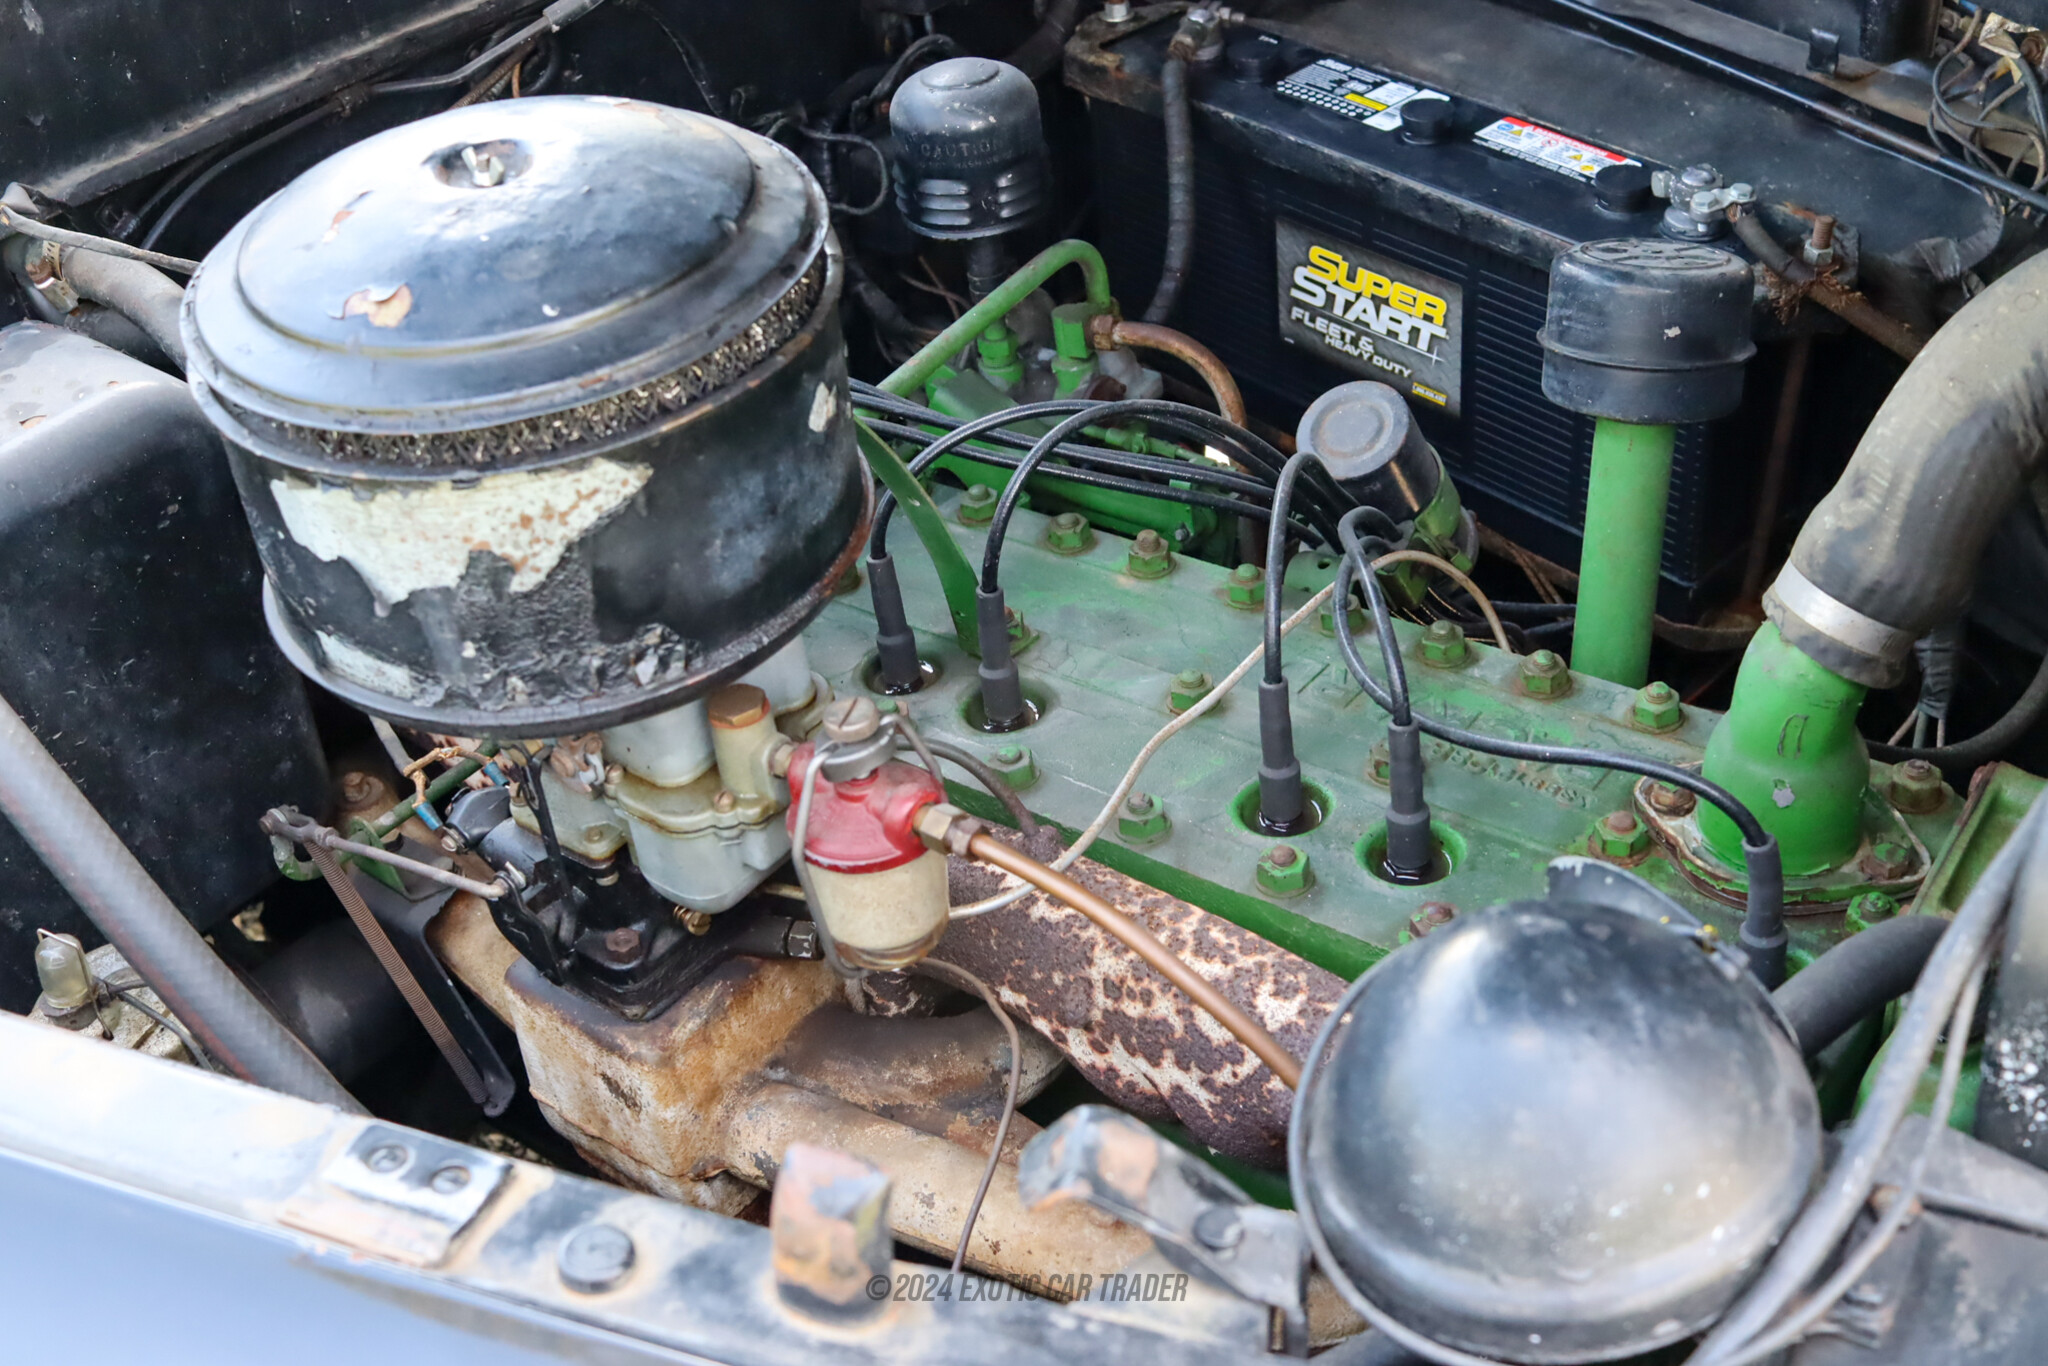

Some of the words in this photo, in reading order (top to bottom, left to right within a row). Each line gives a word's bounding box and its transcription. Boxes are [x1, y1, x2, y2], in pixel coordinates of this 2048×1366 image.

[1290, 265, 1448, 353] START
[1306, 245, 1447, 326] SUPER
[1290, 306, 1356, 341] FLEET
[1358, 335, 1375, 353] &
[1325, 335, 1371, 361] HEAVY
[1372, 355, 1413, 378] DUTY
